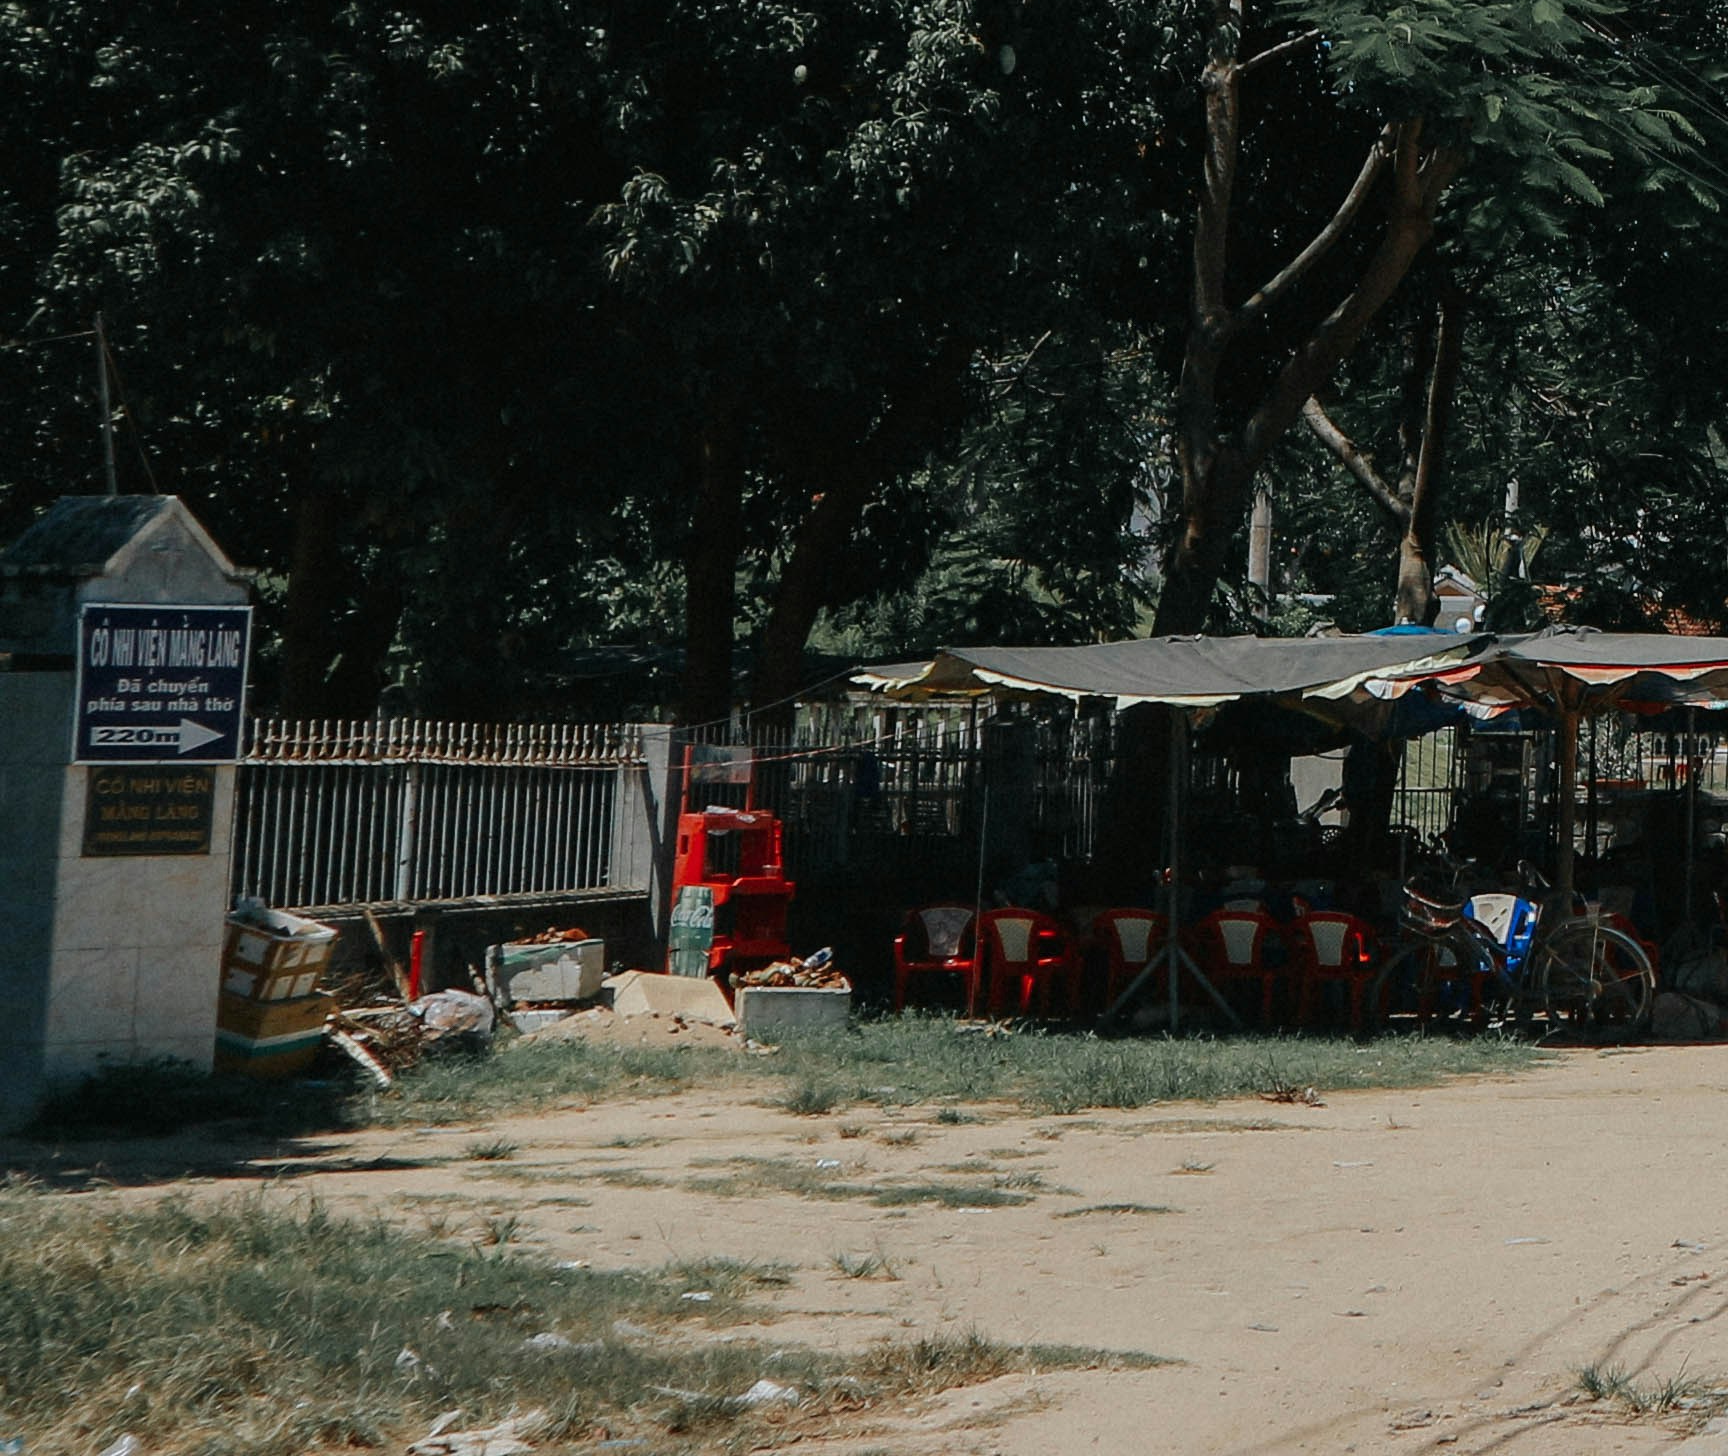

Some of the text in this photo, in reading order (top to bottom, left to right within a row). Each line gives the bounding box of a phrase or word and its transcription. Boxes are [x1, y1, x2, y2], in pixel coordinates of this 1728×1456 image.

[90, 617, 109, 667] CÔ
[111, 629, 136, 667] NHI
[137, 618, 168, 675] VIỆN
[117, 678, 142, 693] Đã
[86, 697, 125, 714] phía
[131, 700, 161, 712] sau
[168, 697, 199, 712] nhà
[96, 729, 179, 743] 220m
